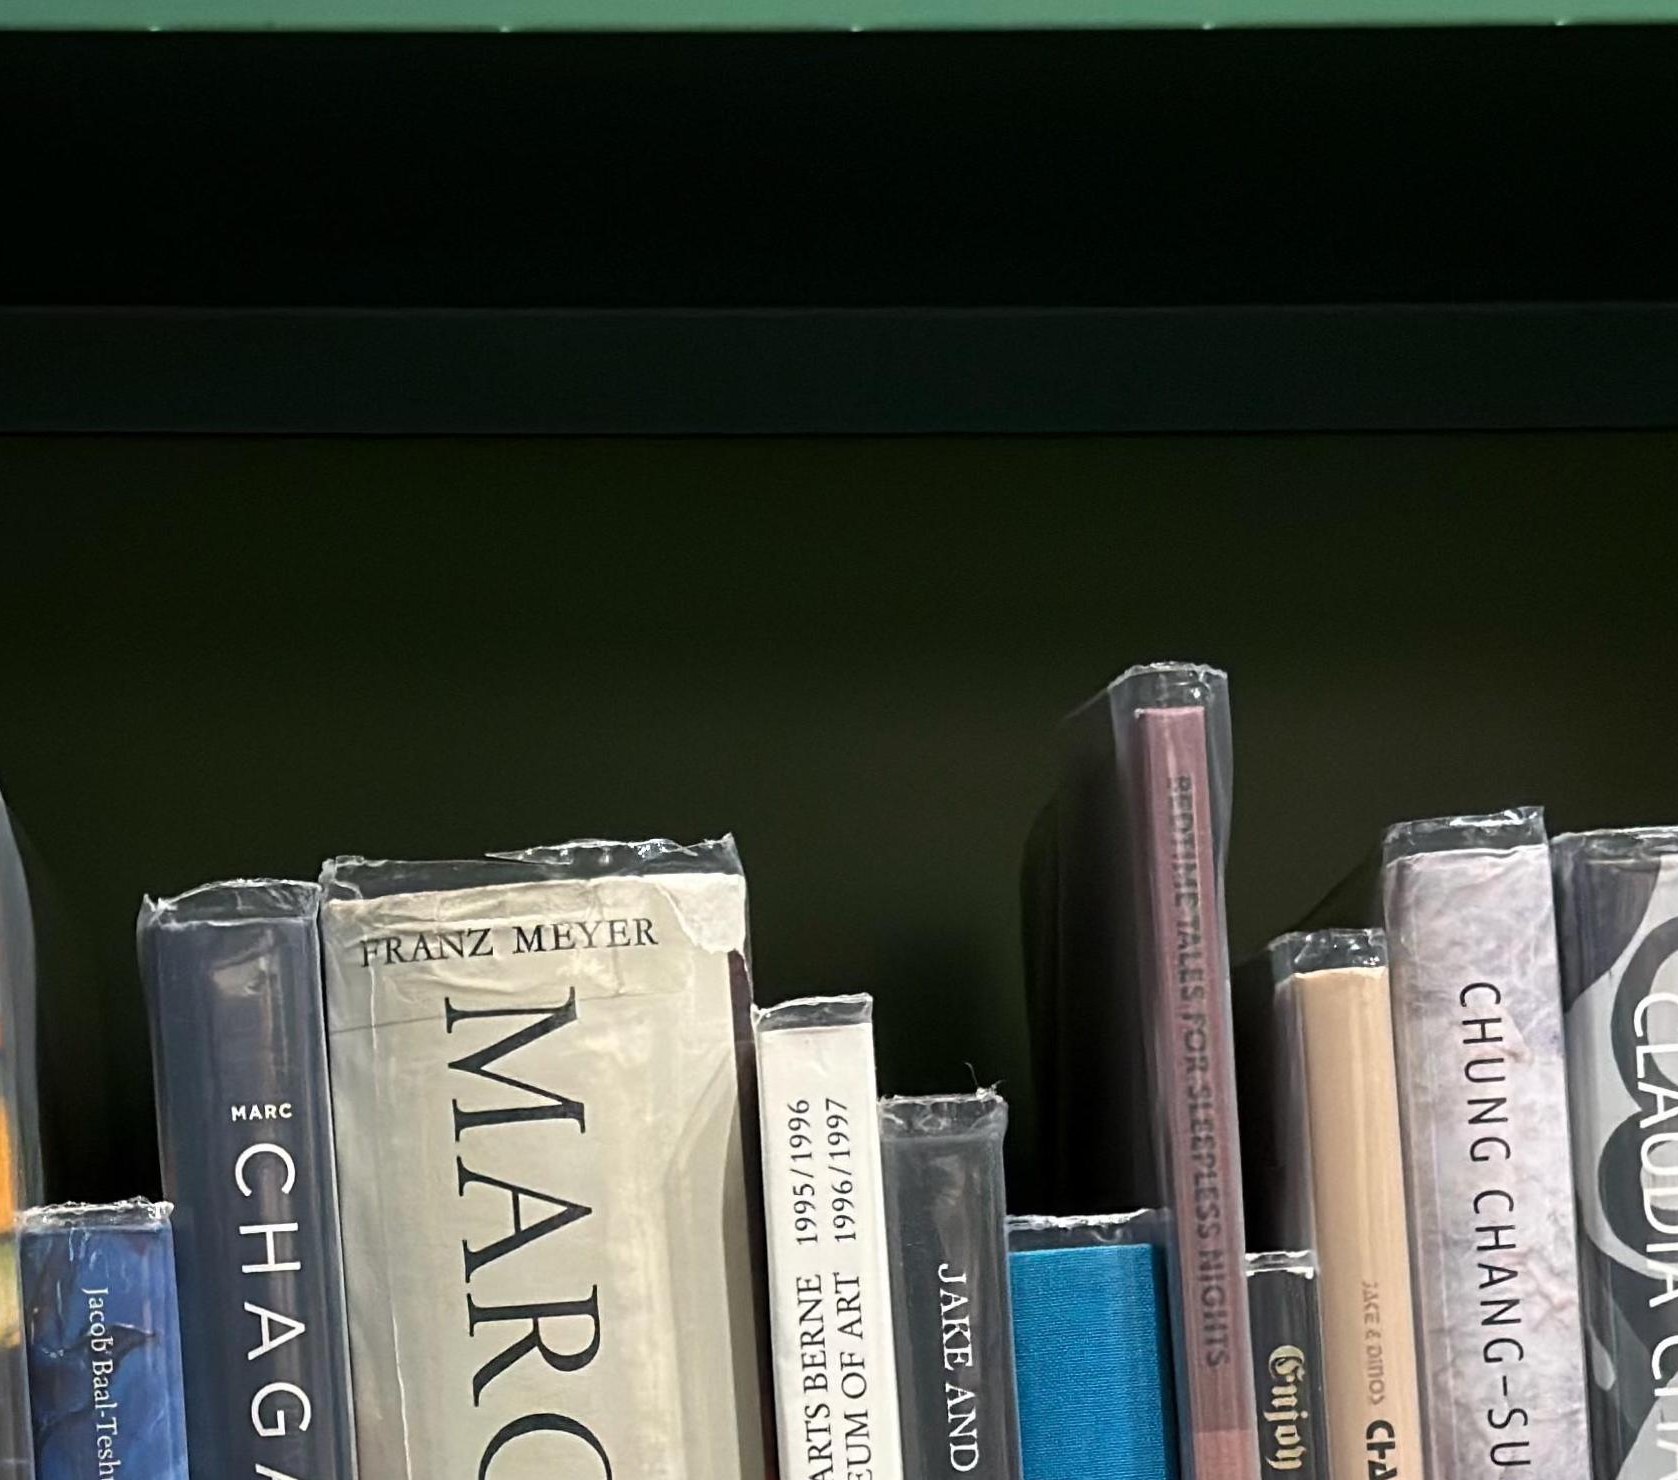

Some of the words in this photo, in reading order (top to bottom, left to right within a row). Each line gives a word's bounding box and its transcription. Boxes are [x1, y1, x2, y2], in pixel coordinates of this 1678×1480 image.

[359, 925, 495, 968] FRANZ
[512, 916, 659, 956] MEYER
[230, 1101, 293, 1122] MARC
[1458, 981, 1511, 1164] CHUNG
[788, 1099, 818, 1246] 1995/1996
[824, 1097, 857, 1242] 1996/1997
[795, 1273, 829, 1393] BERNE
[833, 1271, 864, 1340] ART
[937, 1262, 975, 1372] JAKE
[840, 1350, 868, 1399] OF
[944, 1384, 980, 1473] AND
[1262, 1343, 1310, 1471] Enjoy
